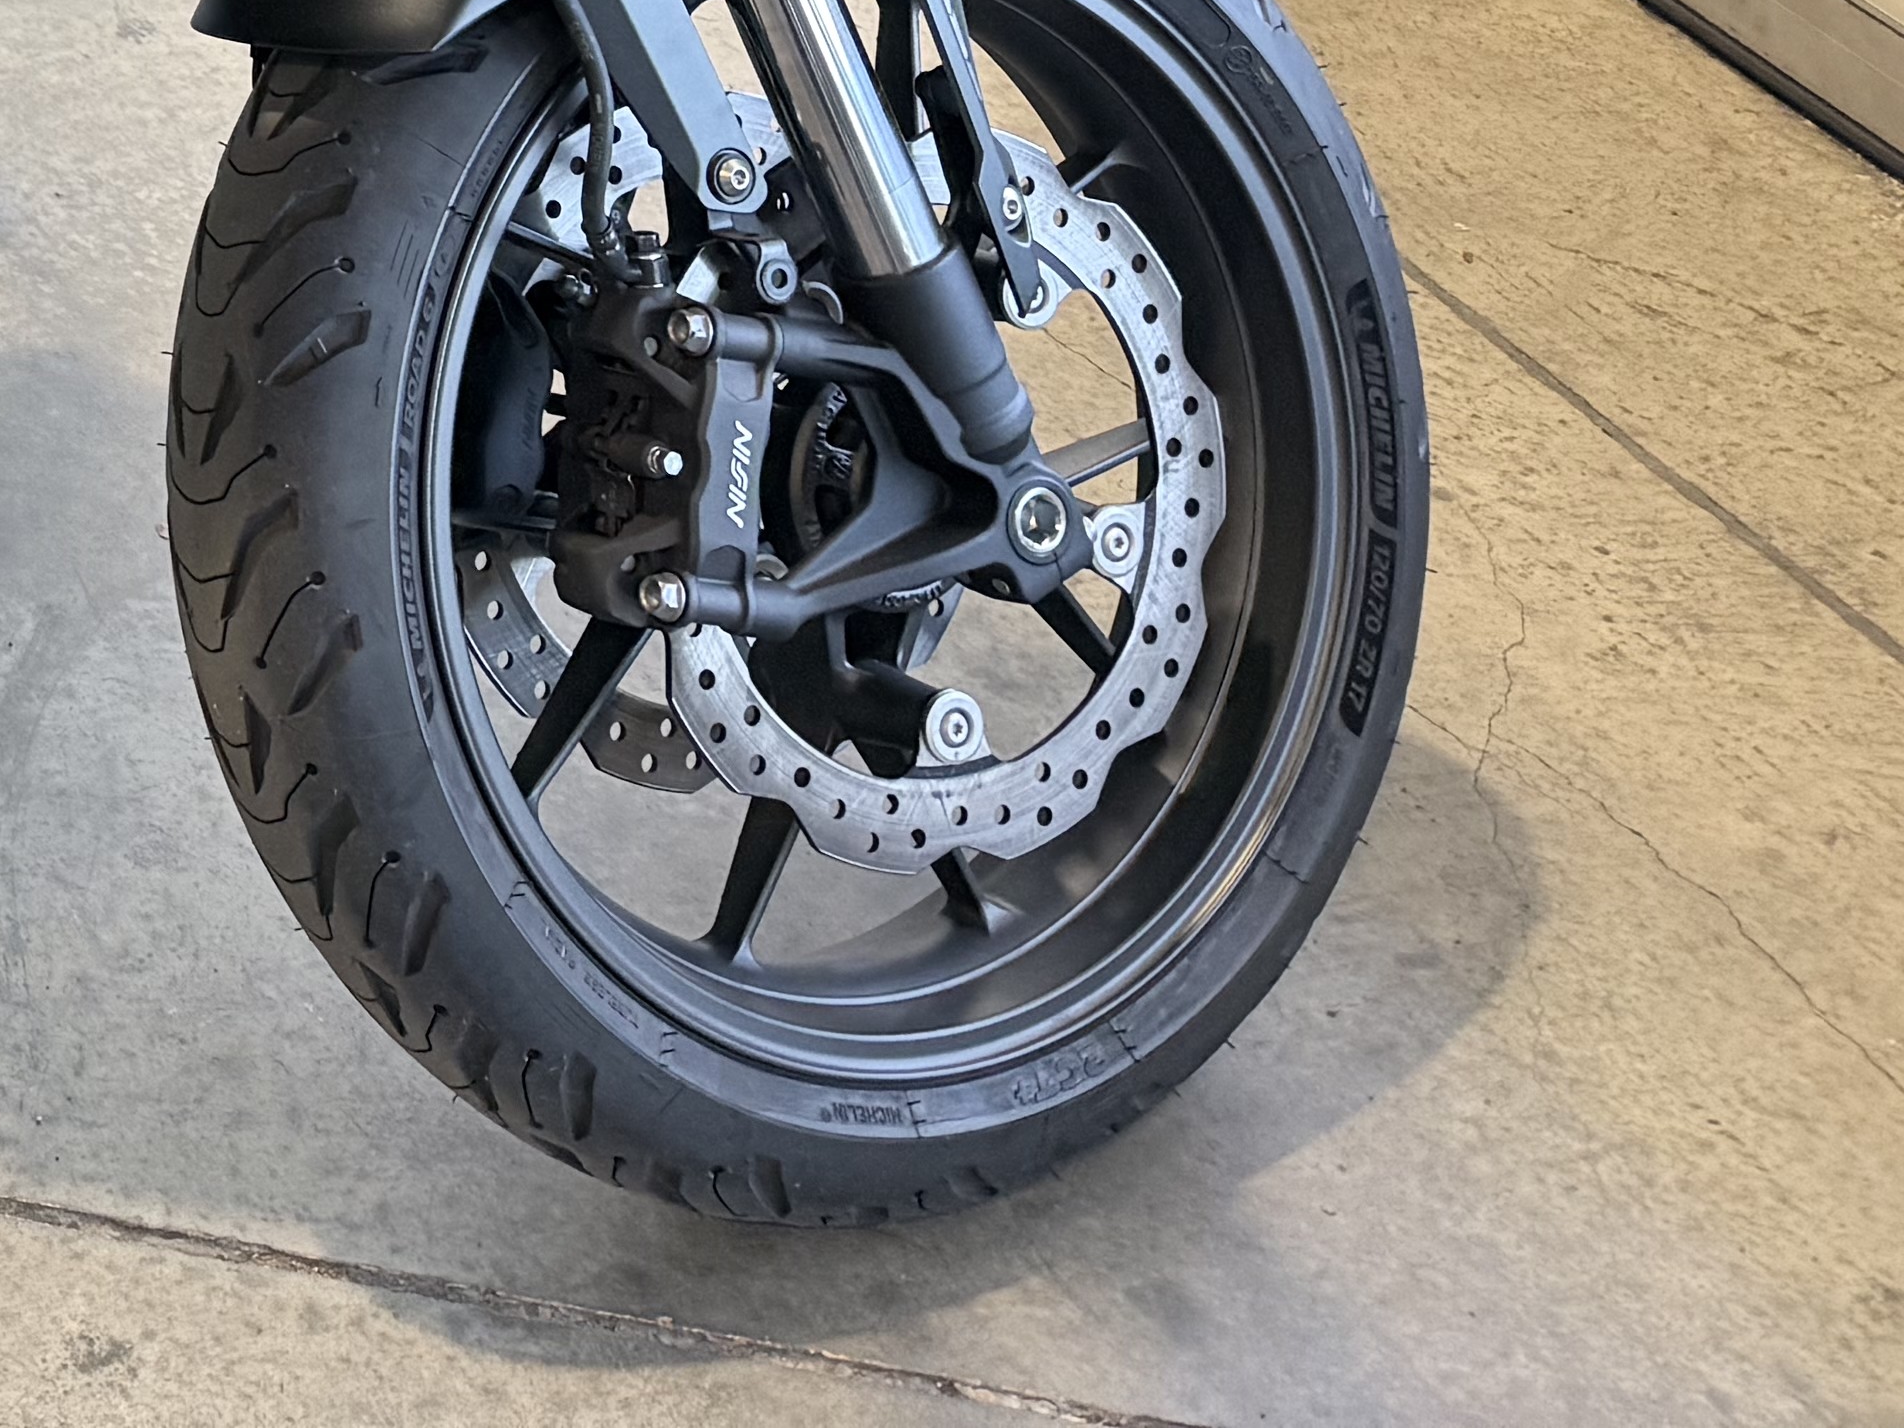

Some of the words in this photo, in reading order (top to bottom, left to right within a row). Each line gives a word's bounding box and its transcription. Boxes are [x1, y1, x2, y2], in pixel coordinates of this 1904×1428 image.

[403, 332, 429, 428] ROAD
[1365, 346, 1395, 514] MICHELIN
[398, 465, 425, 650] MICHELIN
[1364, 543, 1390, 633] 120/70
[1347, 686, 1363, 714] 17
[1354, 643, 1379, 681] ZR
